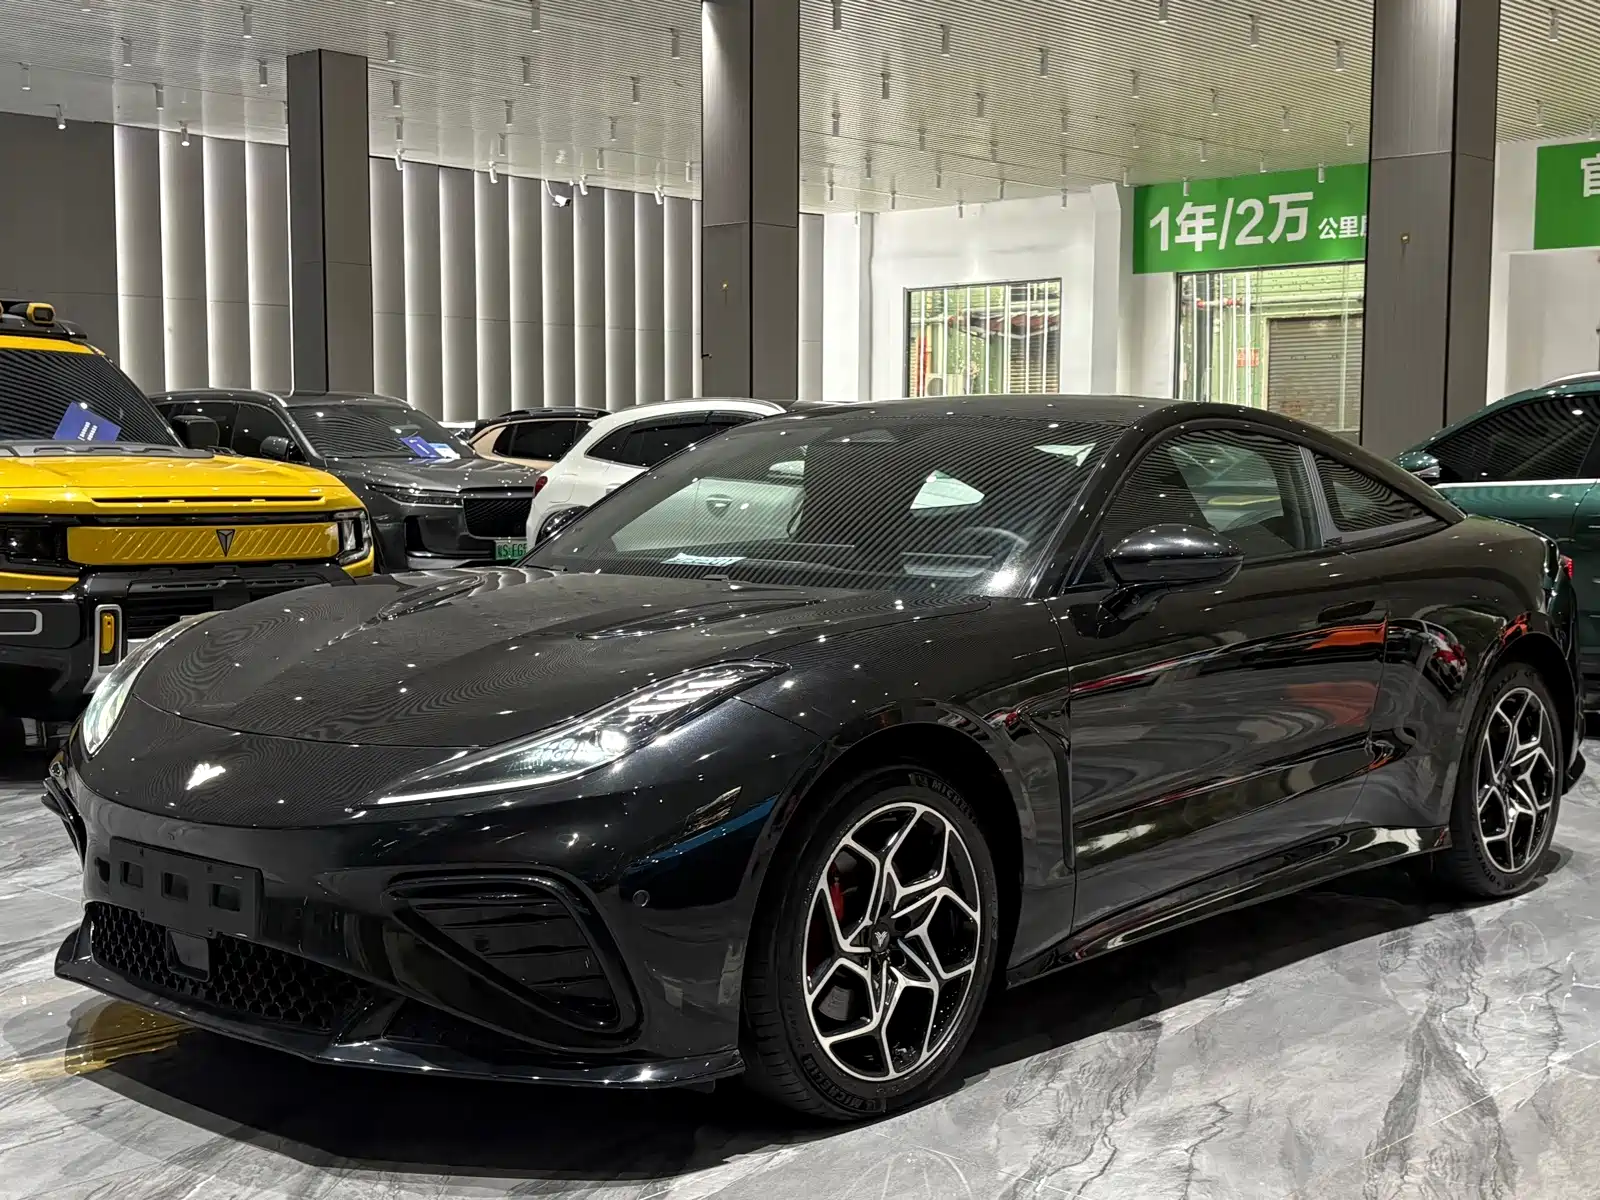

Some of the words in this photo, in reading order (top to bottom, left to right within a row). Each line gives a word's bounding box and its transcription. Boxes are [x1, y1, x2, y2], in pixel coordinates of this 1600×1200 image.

[1150, 192, 1313, 252] 1年/2万
[1318, 215, 1367, 239] 公里
[931, 779, 979, 824] MICHEL
